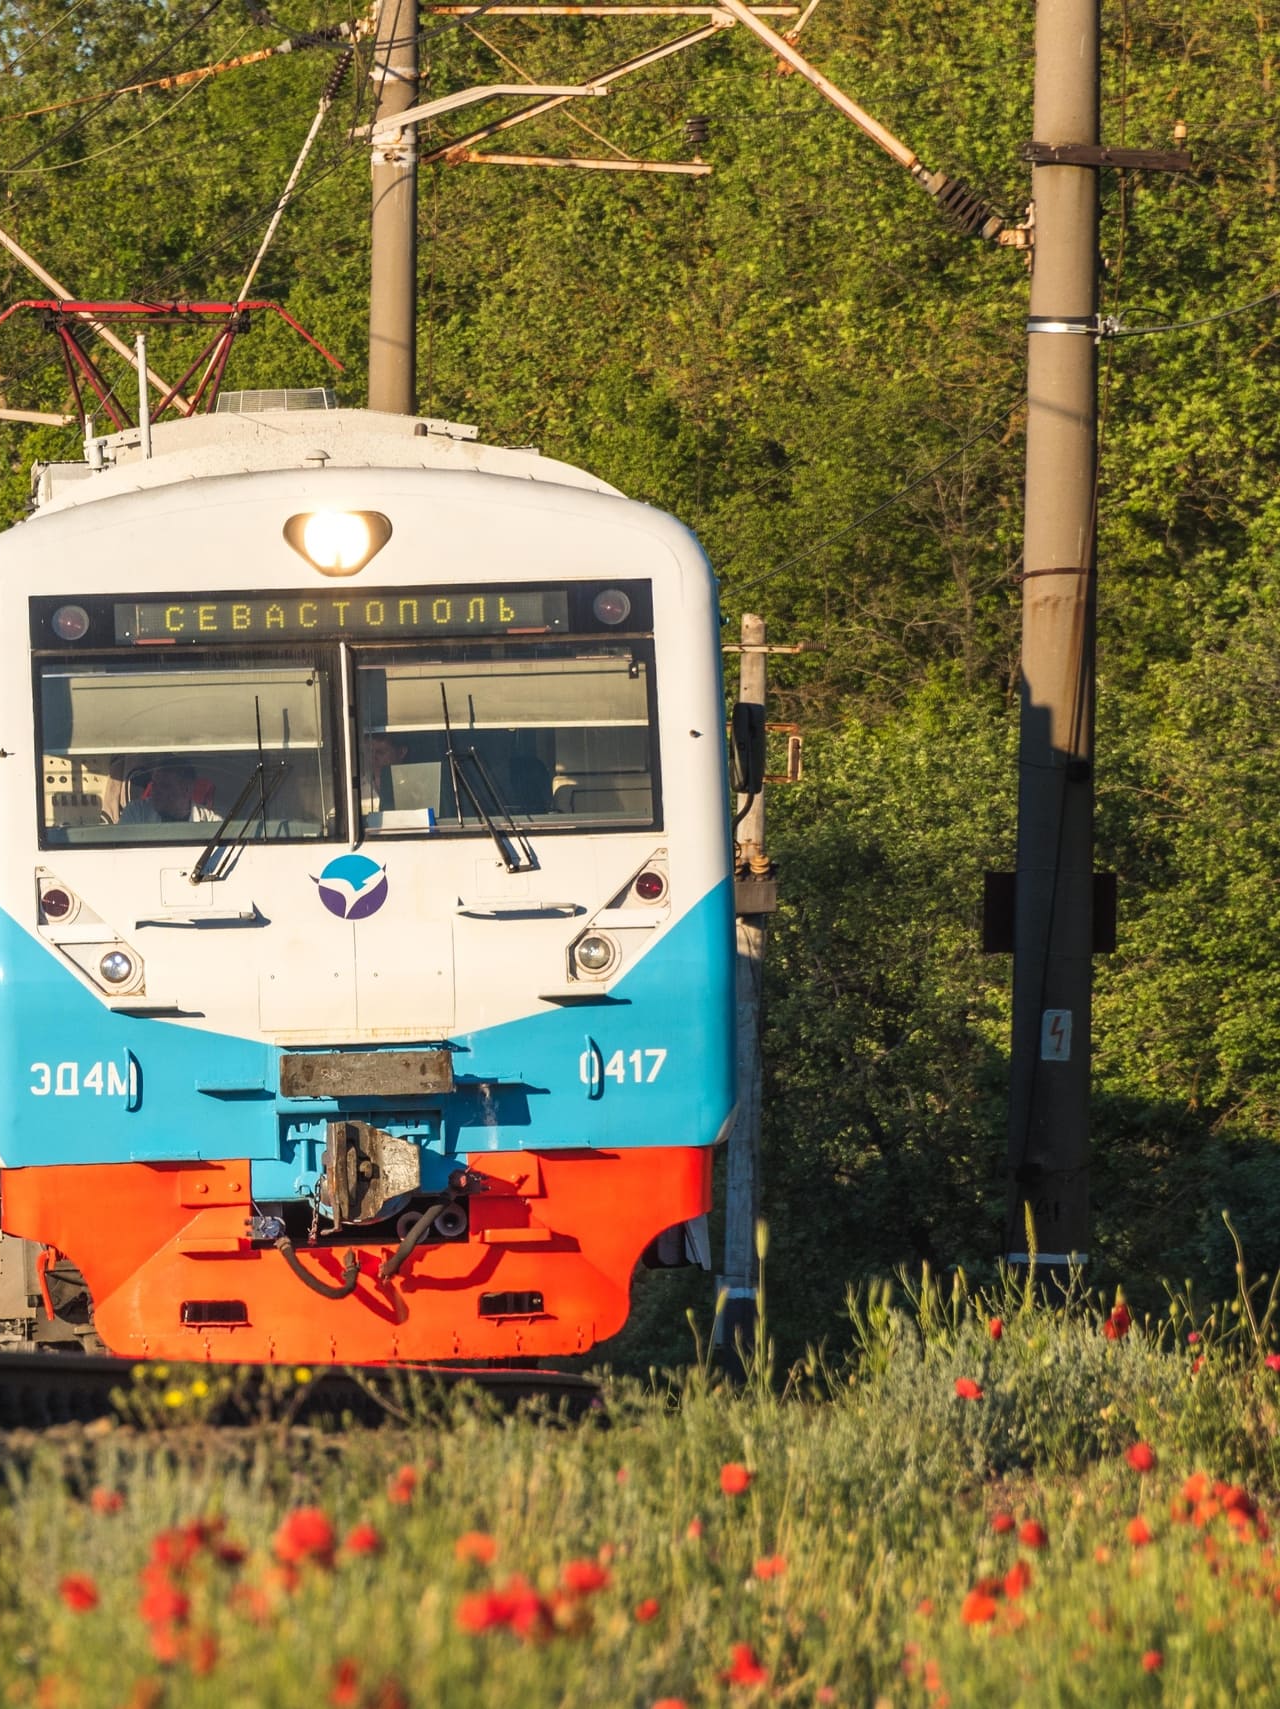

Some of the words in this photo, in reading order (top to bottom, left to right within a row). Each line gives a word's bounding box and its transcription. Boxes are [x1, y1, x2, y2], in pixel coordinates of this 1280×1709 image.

[165, 597, 515, 632] СЕВАСТОПОЛЬ
[30, 1062, 138, 1095] ЭД4М
[580, 1048, 667, 1083] 0417
